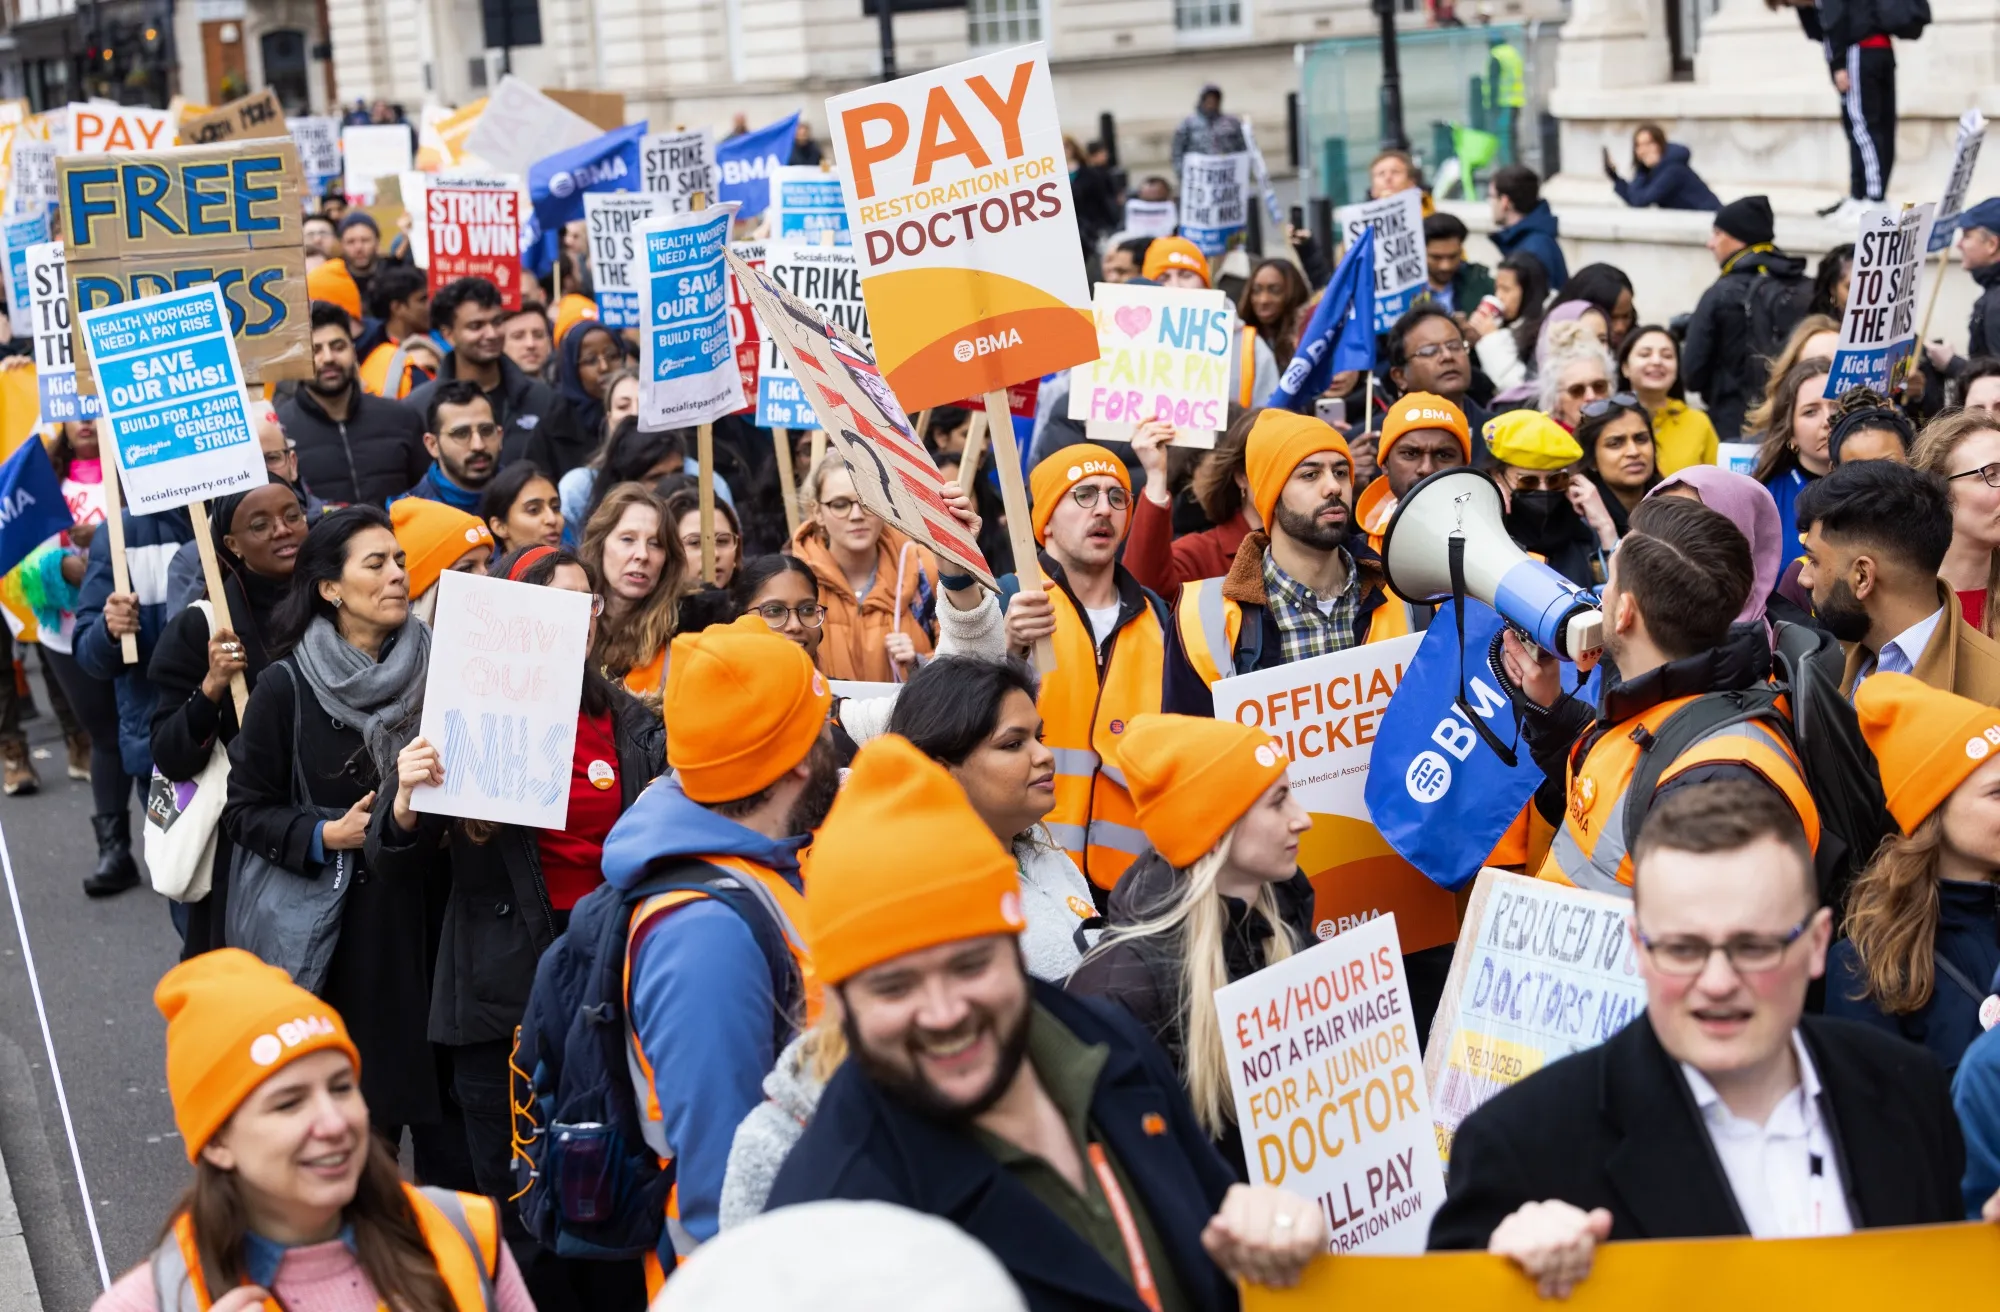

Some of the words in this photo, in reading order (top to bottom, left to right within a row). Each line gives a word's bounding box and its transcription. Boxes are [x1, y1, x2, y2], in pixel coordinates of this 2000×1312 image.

[76, 112, 165, 150] PAY
[841, 60, 1035, 200] PAY
[574, 155, 628, 190] BMA
[647, 142, 704, 173] STRIKE
[722, 153, 781, 186] BMA
[678, 164, 711, 195] SAVE
[860, 168, 1009, 225] RESTORATION
[1013, 156, 1056, 184] FOR
[65, 153, 284, 248] FREE
[429, 190, 516, 224] STRIKE
[430, 223, 463, 256] TO
[467, 224, 518, 257] WIN
[864, 182, 1062, 266] DOCTORS
[594, 236, 617, 260] TO
[650, 234, 693, 252] HEALTH
[657, 249, 687, 266] NEED
[689, 247, 698, 260] A
[794, 251, 829, 263] Socialist
[831, 252, 856, 265] Work
[1383, 230, 1419, 264] SAVE
[1860, 226, 1920, 267] STRIKE
[598, 263, 631, 287] THE
[678, 270, 718, 296] SAVE
[772, 264, 863, 302] STRIKE
[1396, 256, 1423, 286] NHS
[1854, 269, 1884, 306] TO
[37, 297, 70, 331] TO
[75, 267, 288, 362] PSS
[91, 314, 142, 339] HEALTH
[143, 299, 215, 325] WORKERS
[657, 297, 699, 321] OUR
[1849, 307, 1889, 344] THE
[1889, 299, 1914, 340] NHS
[100, 332, 136, 352] NEED
[139, 328, 150, 343] A
[151, 323, 178, 342] PAY
[180, 315, 213, 333] RISE
[659, 330, 691, 348] BUILD
[693, 325, 712, 341] FOR
[976, 327, 1023, 356] BMA
[1158, 305, 1228, 357] NHS
[40, 332, 75, 367] TH
[131, 349, 196, 382] SAVE
[1841, 355, 1871, 374] Kick
[111, 381, 163, 408] OUR
[169, 363, 228, 396] NHS!
[1091, 346, 1175, 389] FAIR
[1182, 353, 1228, 397] PAY
[49, 399, 75, 419] the
[78, 395, 101, 416] Tor
[768, 380, 799, 403] Kick
[119, 414, 161, 435] BUILD
[162, 408, 189, 426] FOR
[190, 404, 202, 420] A
[203, 395, 241, 417] 24HR
[175, 412, 245, 440] GENERAL
[767, 404, 790, 425] the
[1091, 387, 1144, 424] FOR
[1155, 393, 1220, 431] DOCS
[1422, 408, 1455, 425] BMA
[194, 429, 249, 452] STRIKE
[1083, 459, 1118, 475] BMA
[140, 470, 252, 503] socialistparty.org.uk
[0, 487, 36, 529] MA
[1431, 657, 1510, 762] BM
[444, 708, 570, 808] NHS
[1288, 777, 1307, 790] itish
[1308, 769, 1340, 785] Medical
[1341, 762, 1371, 777] Associa
[336, 850, 344, 870] FAM
[1337, 908, 1381, 934] BMA
[1486, 891, 1596, 963] REDUCED
[1593, 909, 1626, 971] TO
[1236, 959, 1368, 1050] £14/HOUR
[1370, 946, 1394, 987] IS
[1471, 955, 1593, 1035] DOCTORS
[275, 1014, 335, 1048] BMA
[1242, 1043, 1282, 1087] NOT
[1289, 1037, 1302, 1066] A
[1304, 1015, 1346, 1058] FAIR
[1347, 987, 1402, 1034] WAGE
[1249, 1076, 1301, 1130] FOR
[1306, 1068, 1323, 1103] A
[1326, 1023, 1410, 1097] JUNIOR
[1466, 1046, 1523, 1079] REDUCED
[1257, 1064, 1421, 1188] DOCTOR
[1317, 1181, 1365, 1232] LL
[1366, 1146, 1415, 1209] PAY
[1329, 1213, 1390, 1256] ORATION
[1391, 1192, 1423, 1229] NOW
